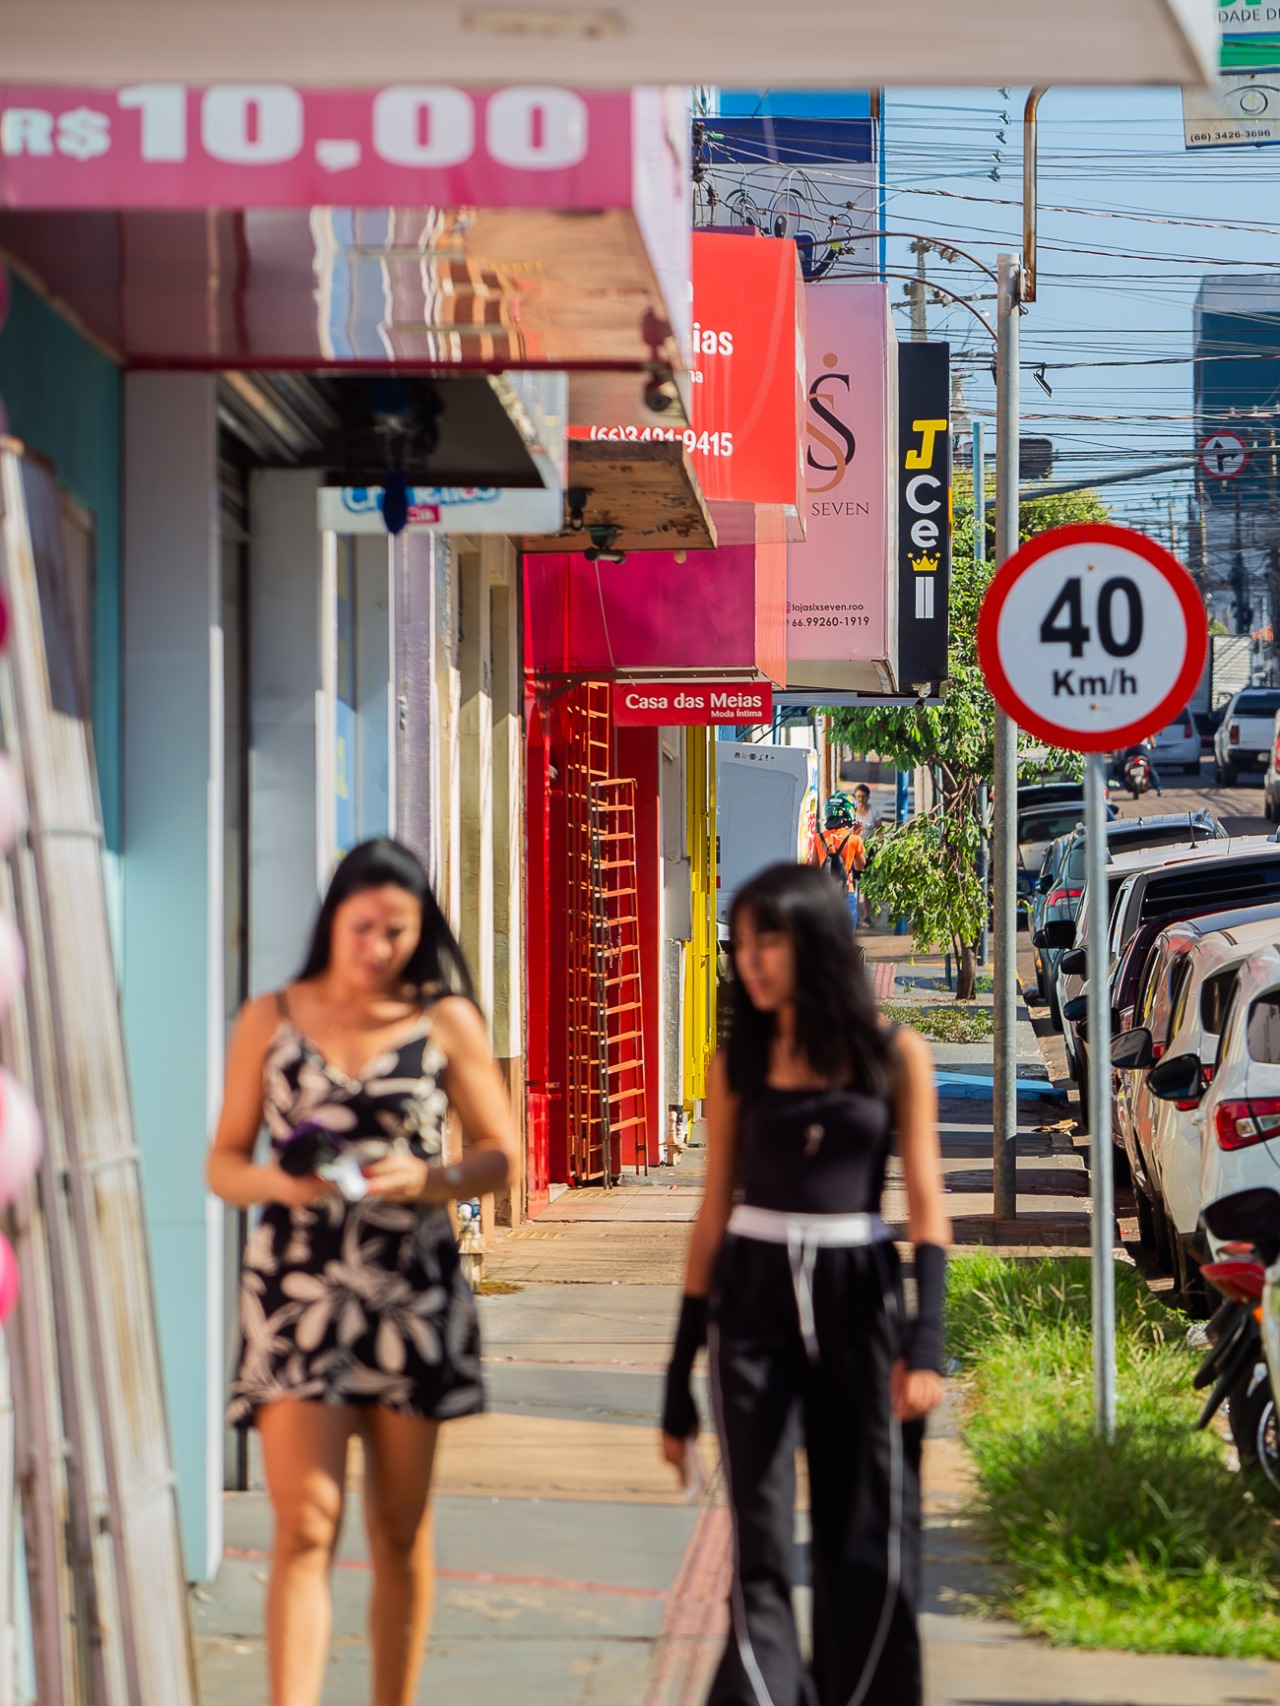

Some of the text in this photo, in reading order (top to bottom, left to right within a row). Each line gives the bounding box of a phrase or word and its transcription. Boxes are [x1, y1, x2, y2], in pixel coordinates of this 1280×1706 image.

[1190, 129, 1271, 142] (66) 3426-3696
[812, 502, 870, 516] SEVEN
[792, 602, 864, 613] lojasixseven.roo
[792, 616, 870, 627] 66.99260-1919
[1040, 576, 1144, 658] 40
[1053, 667, 1137, 696] Km/h
[625, 692, 762, 709] Casa das Meias
[711, 708, 762, 718] Moda Íntima
